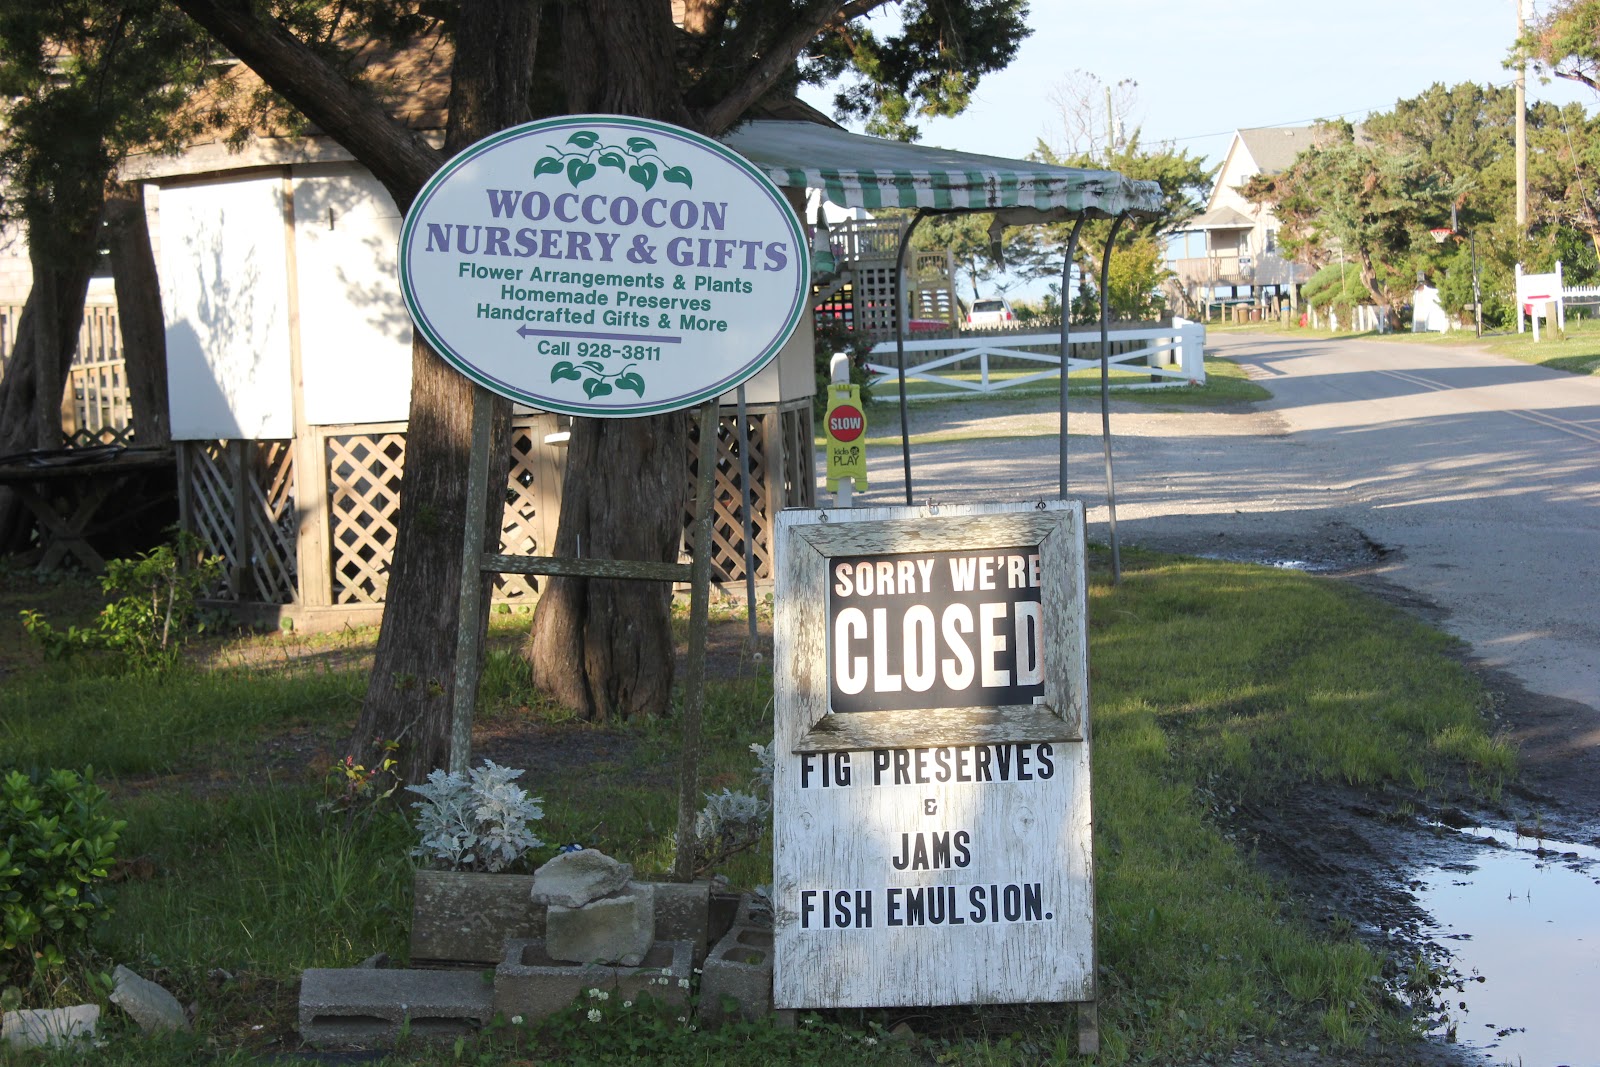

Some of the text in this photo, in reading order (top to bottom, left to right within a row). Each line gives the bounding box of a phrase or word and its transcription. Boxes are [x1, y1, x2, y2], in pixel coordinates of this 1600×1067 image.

[486, 189, 728, 231] WOCCOCON
[425, 224, 788, 272] NURSERY & GIFTS
[459, 262, 753, 294] Flower Arrangements & Plants
[501, 285, 711, 312] Homemade Preserves
[477, 303, 728, 331] Handcrafted Gifts & More
[537, 340, 661, 361] Call 928-3811
[831, 417, 860, 430] SLOW
[833, 455, 859, 466] PLAY
[834, 560, 935, 598] SORRY
[834, 601, 1044, 694] CLOSED
[801, 743, 1055, 788] FIG PRESERVES
[924, 798, 938, 816] &
[892, 831, 971, 870] JAMS
[801, 883, 1053, 929] FISH EMULSION.
